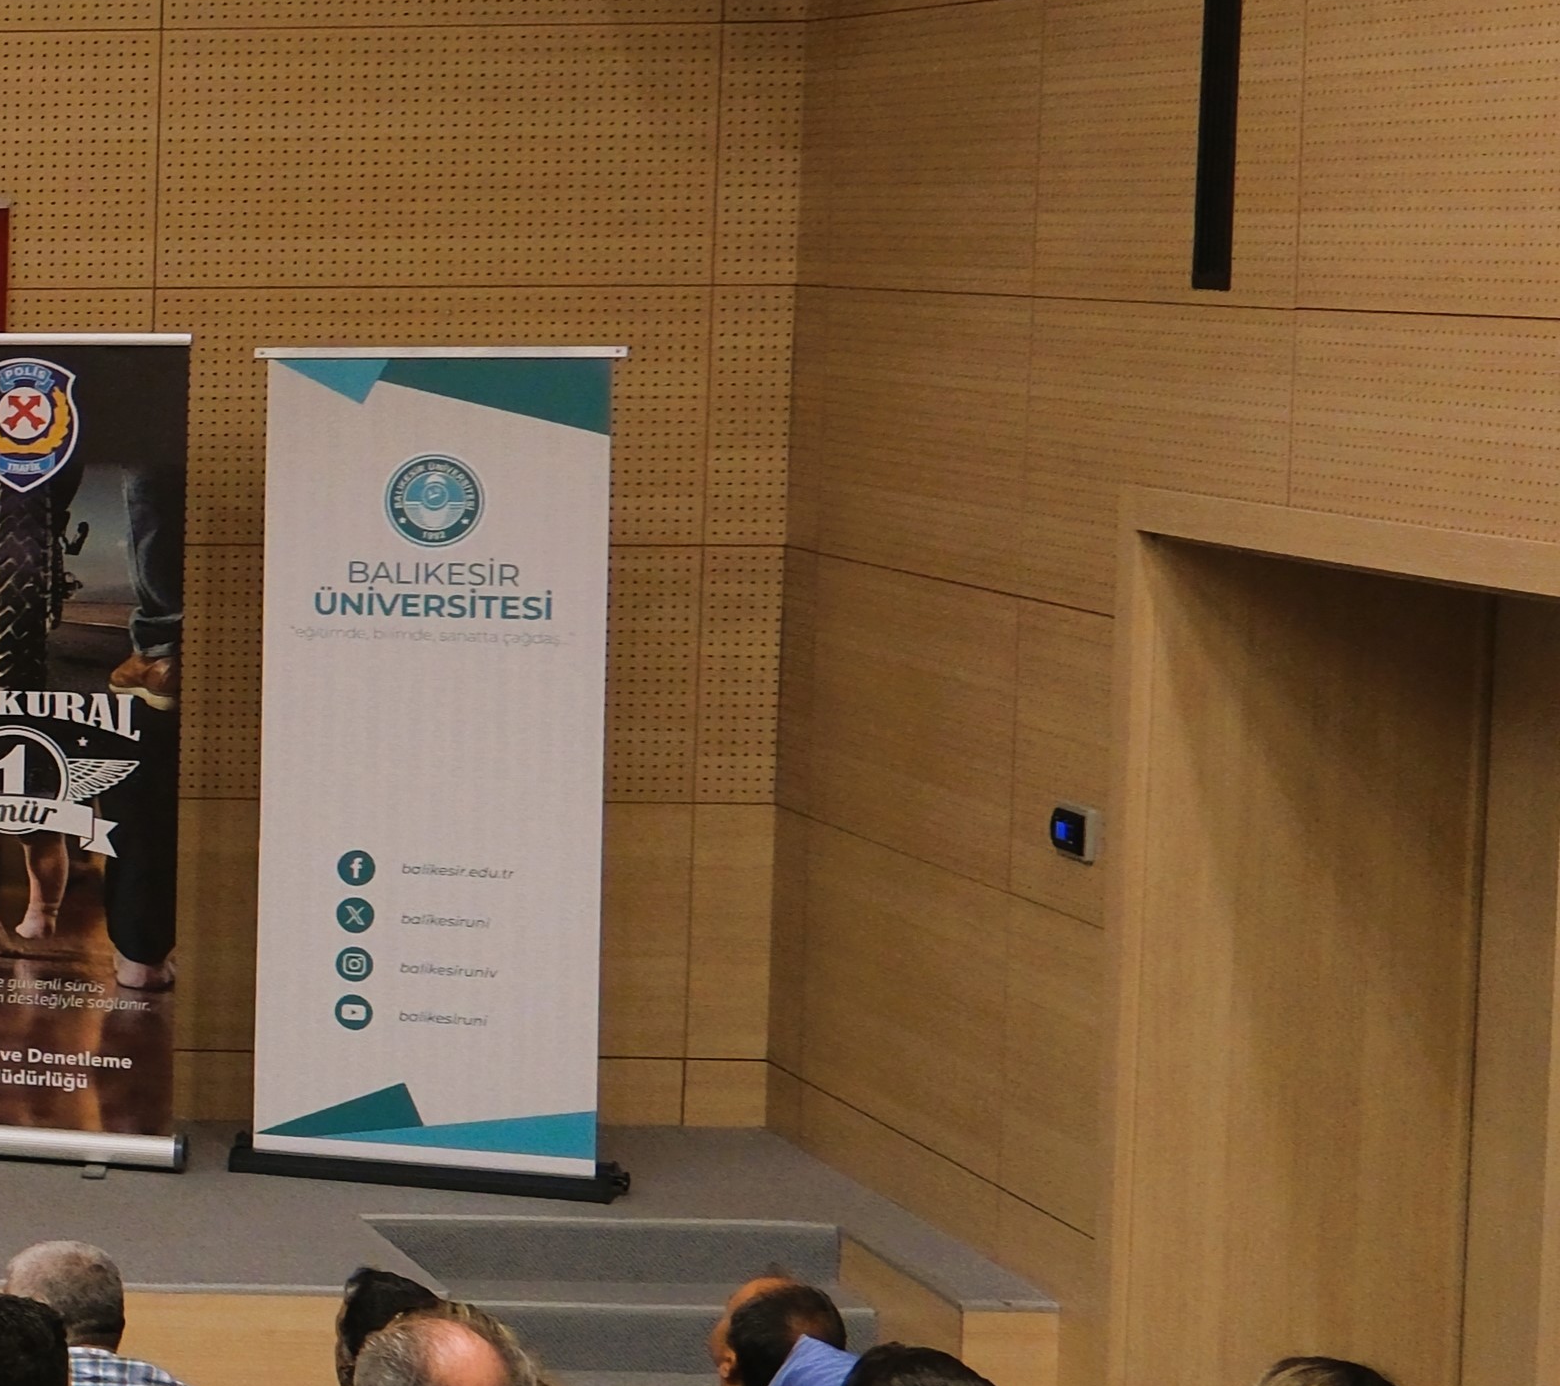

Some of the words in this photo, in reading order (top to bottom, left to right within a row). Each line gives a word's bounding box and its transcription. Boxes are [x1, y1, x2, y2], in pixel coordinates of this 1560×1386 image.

[347, 558, 520, 587] BALIKESİR
[314, 586, 553, 621] ÜNİVERSİTESİ
[0, 1049, 22, 1063] ve
[27, 1048, 133, 1069] Denetleme
